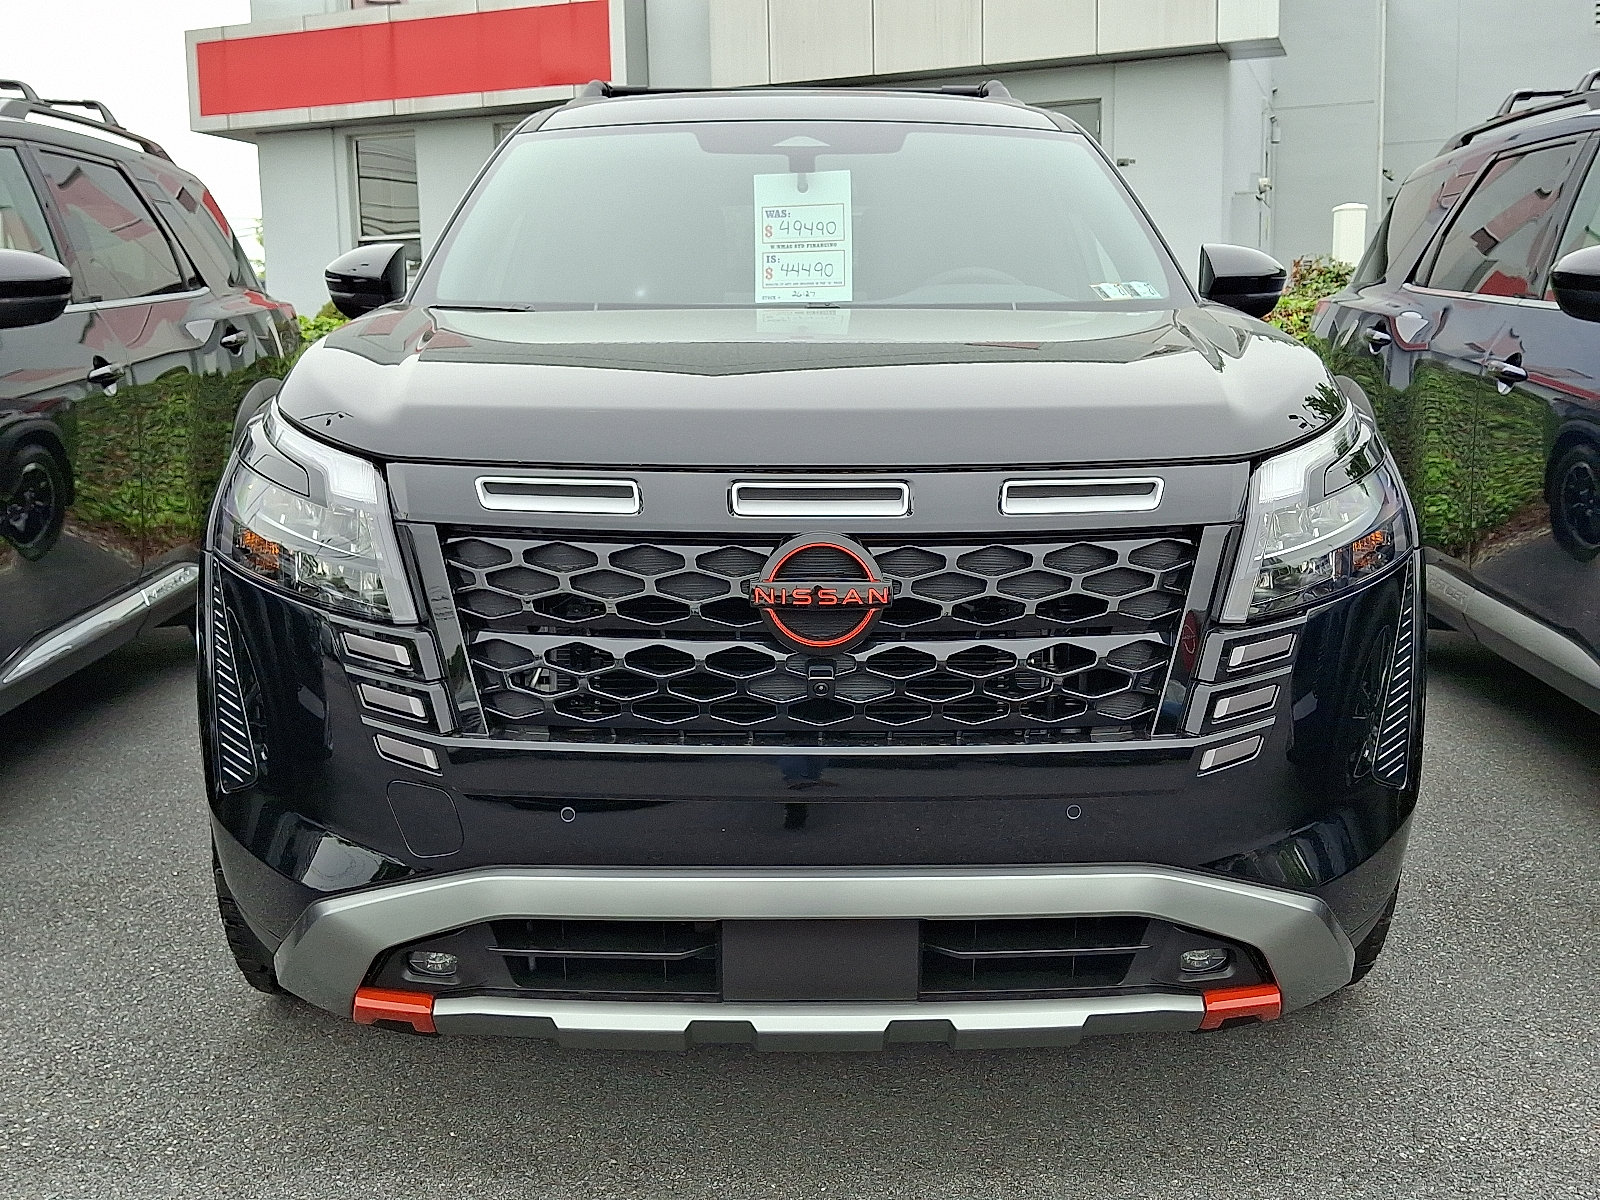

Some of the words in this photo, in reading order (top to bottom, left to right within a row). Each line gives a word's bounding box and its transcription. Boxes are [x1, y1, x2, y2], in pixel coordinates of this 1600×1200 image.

[765, 210, 791, 218] WAS:
[780, 220, 837, 236] 49490
[766, 255, 781, 264] IS:
[780, 262, 834, 277] 44490
[754, 588, 888, 605] NISSAN
